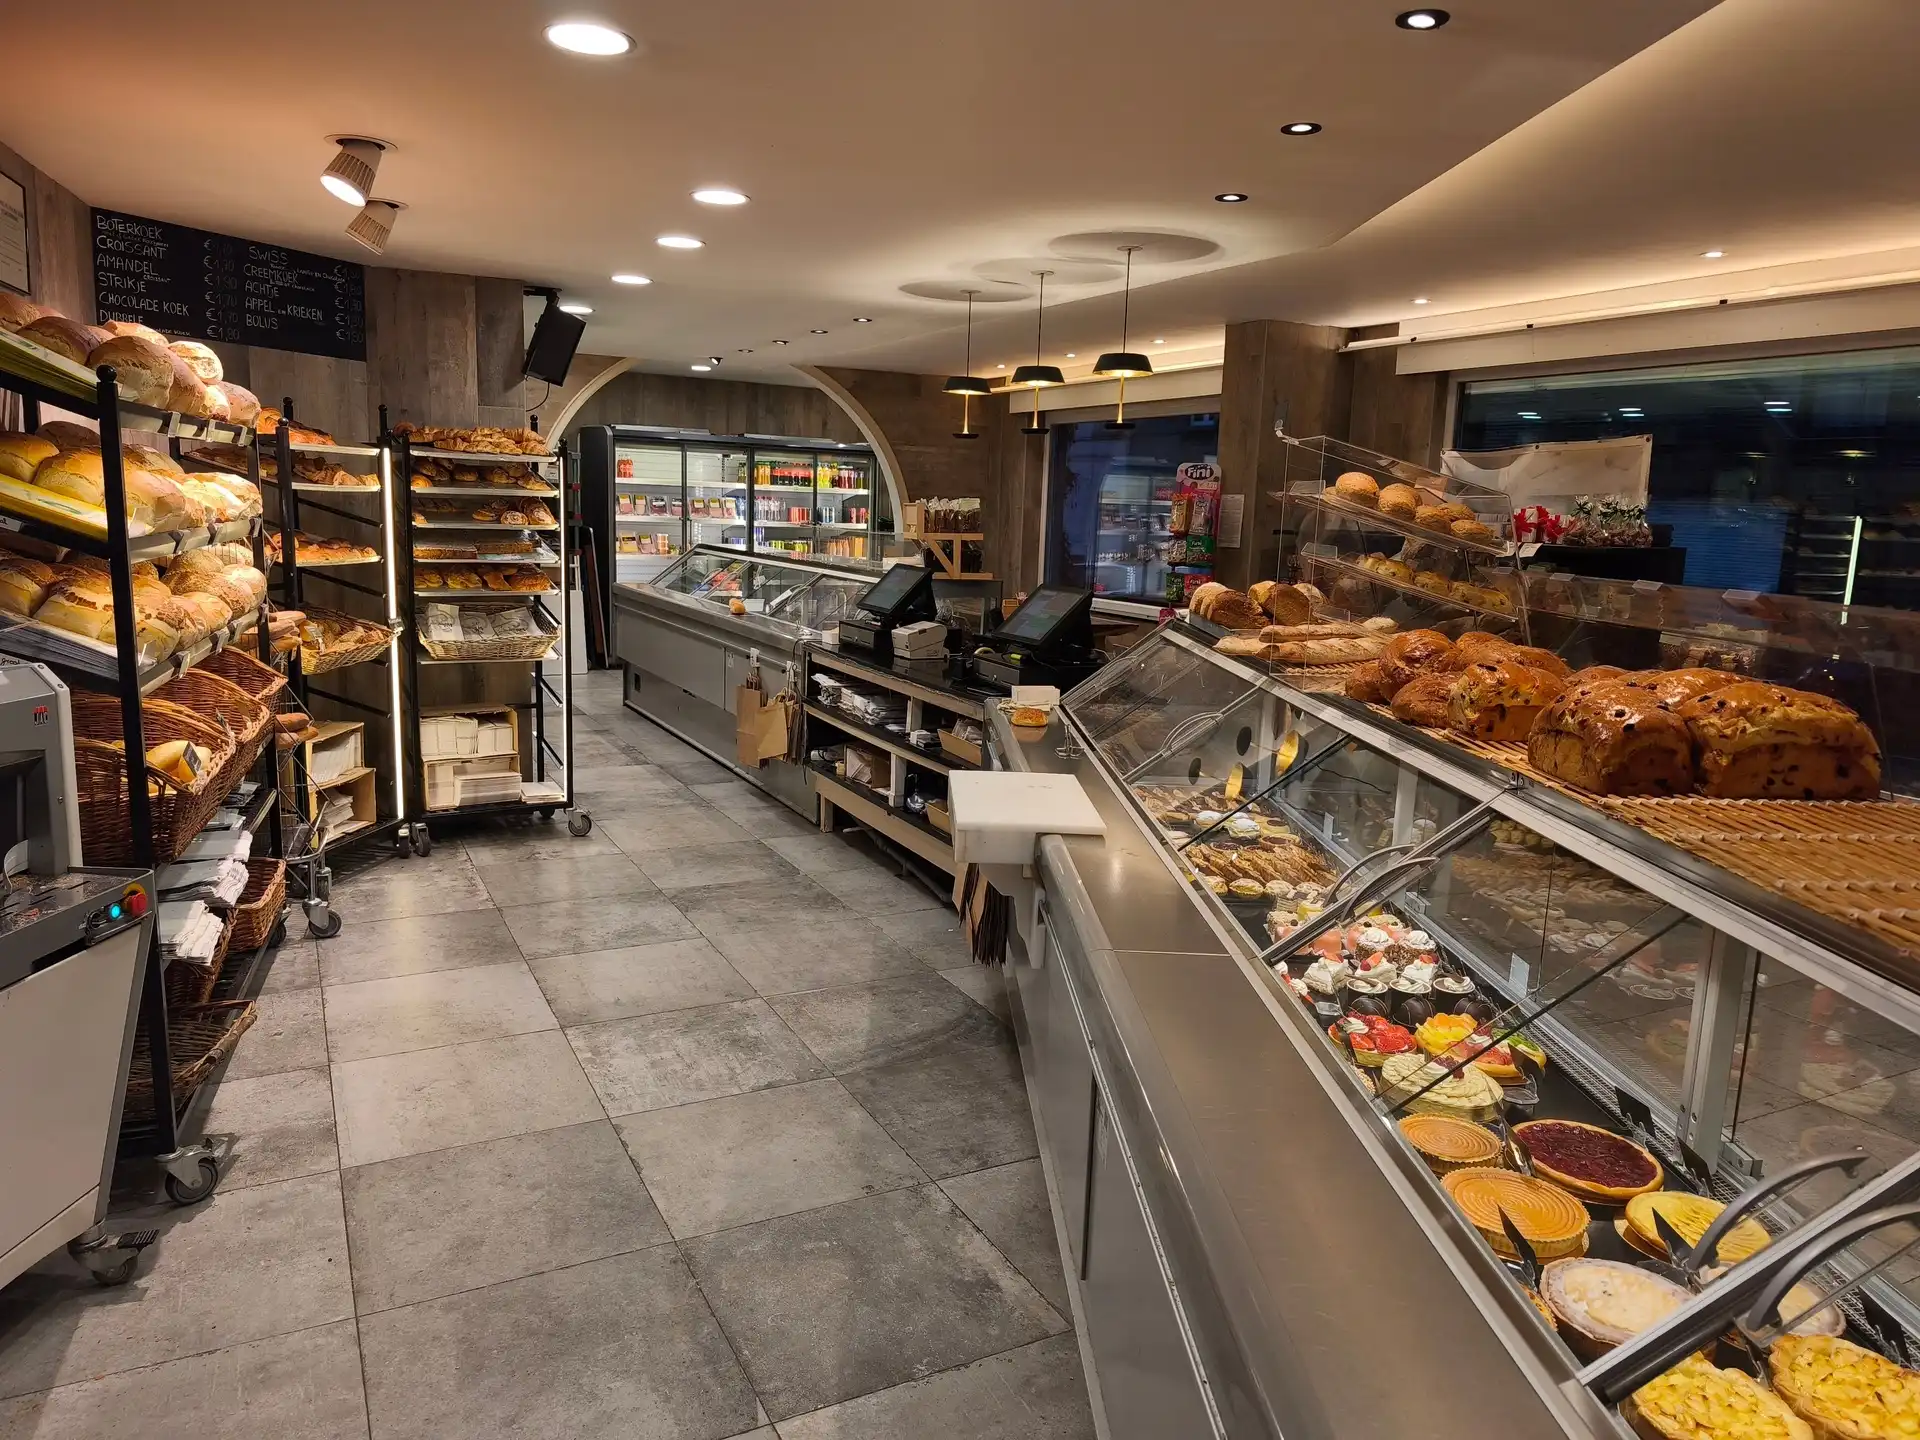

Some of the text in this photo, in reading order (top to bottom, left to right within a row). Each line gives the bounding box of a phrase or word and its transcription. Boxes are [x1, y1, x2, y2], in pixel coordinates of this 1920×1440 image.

[96, 215, 163, 240] BOTERKOEK
[96, 235, 166, 259] CROISSANT
[250, 246, 288, 264] SWISS
[96, 253, 158, 276] AMANDEL
[98, 272, 146, 294] STRIKJE
[245, 280, 280, 298] ACHTJE
[99, 292, 190, 316] CHOCOLADE KOEK
[245, 297, 275, 313] APPEL
[287, 304, 323, 321] KRIEKEN
[246, 314, 278, 329] BOLUS
[1187, 464, 1211, 478] Fini
